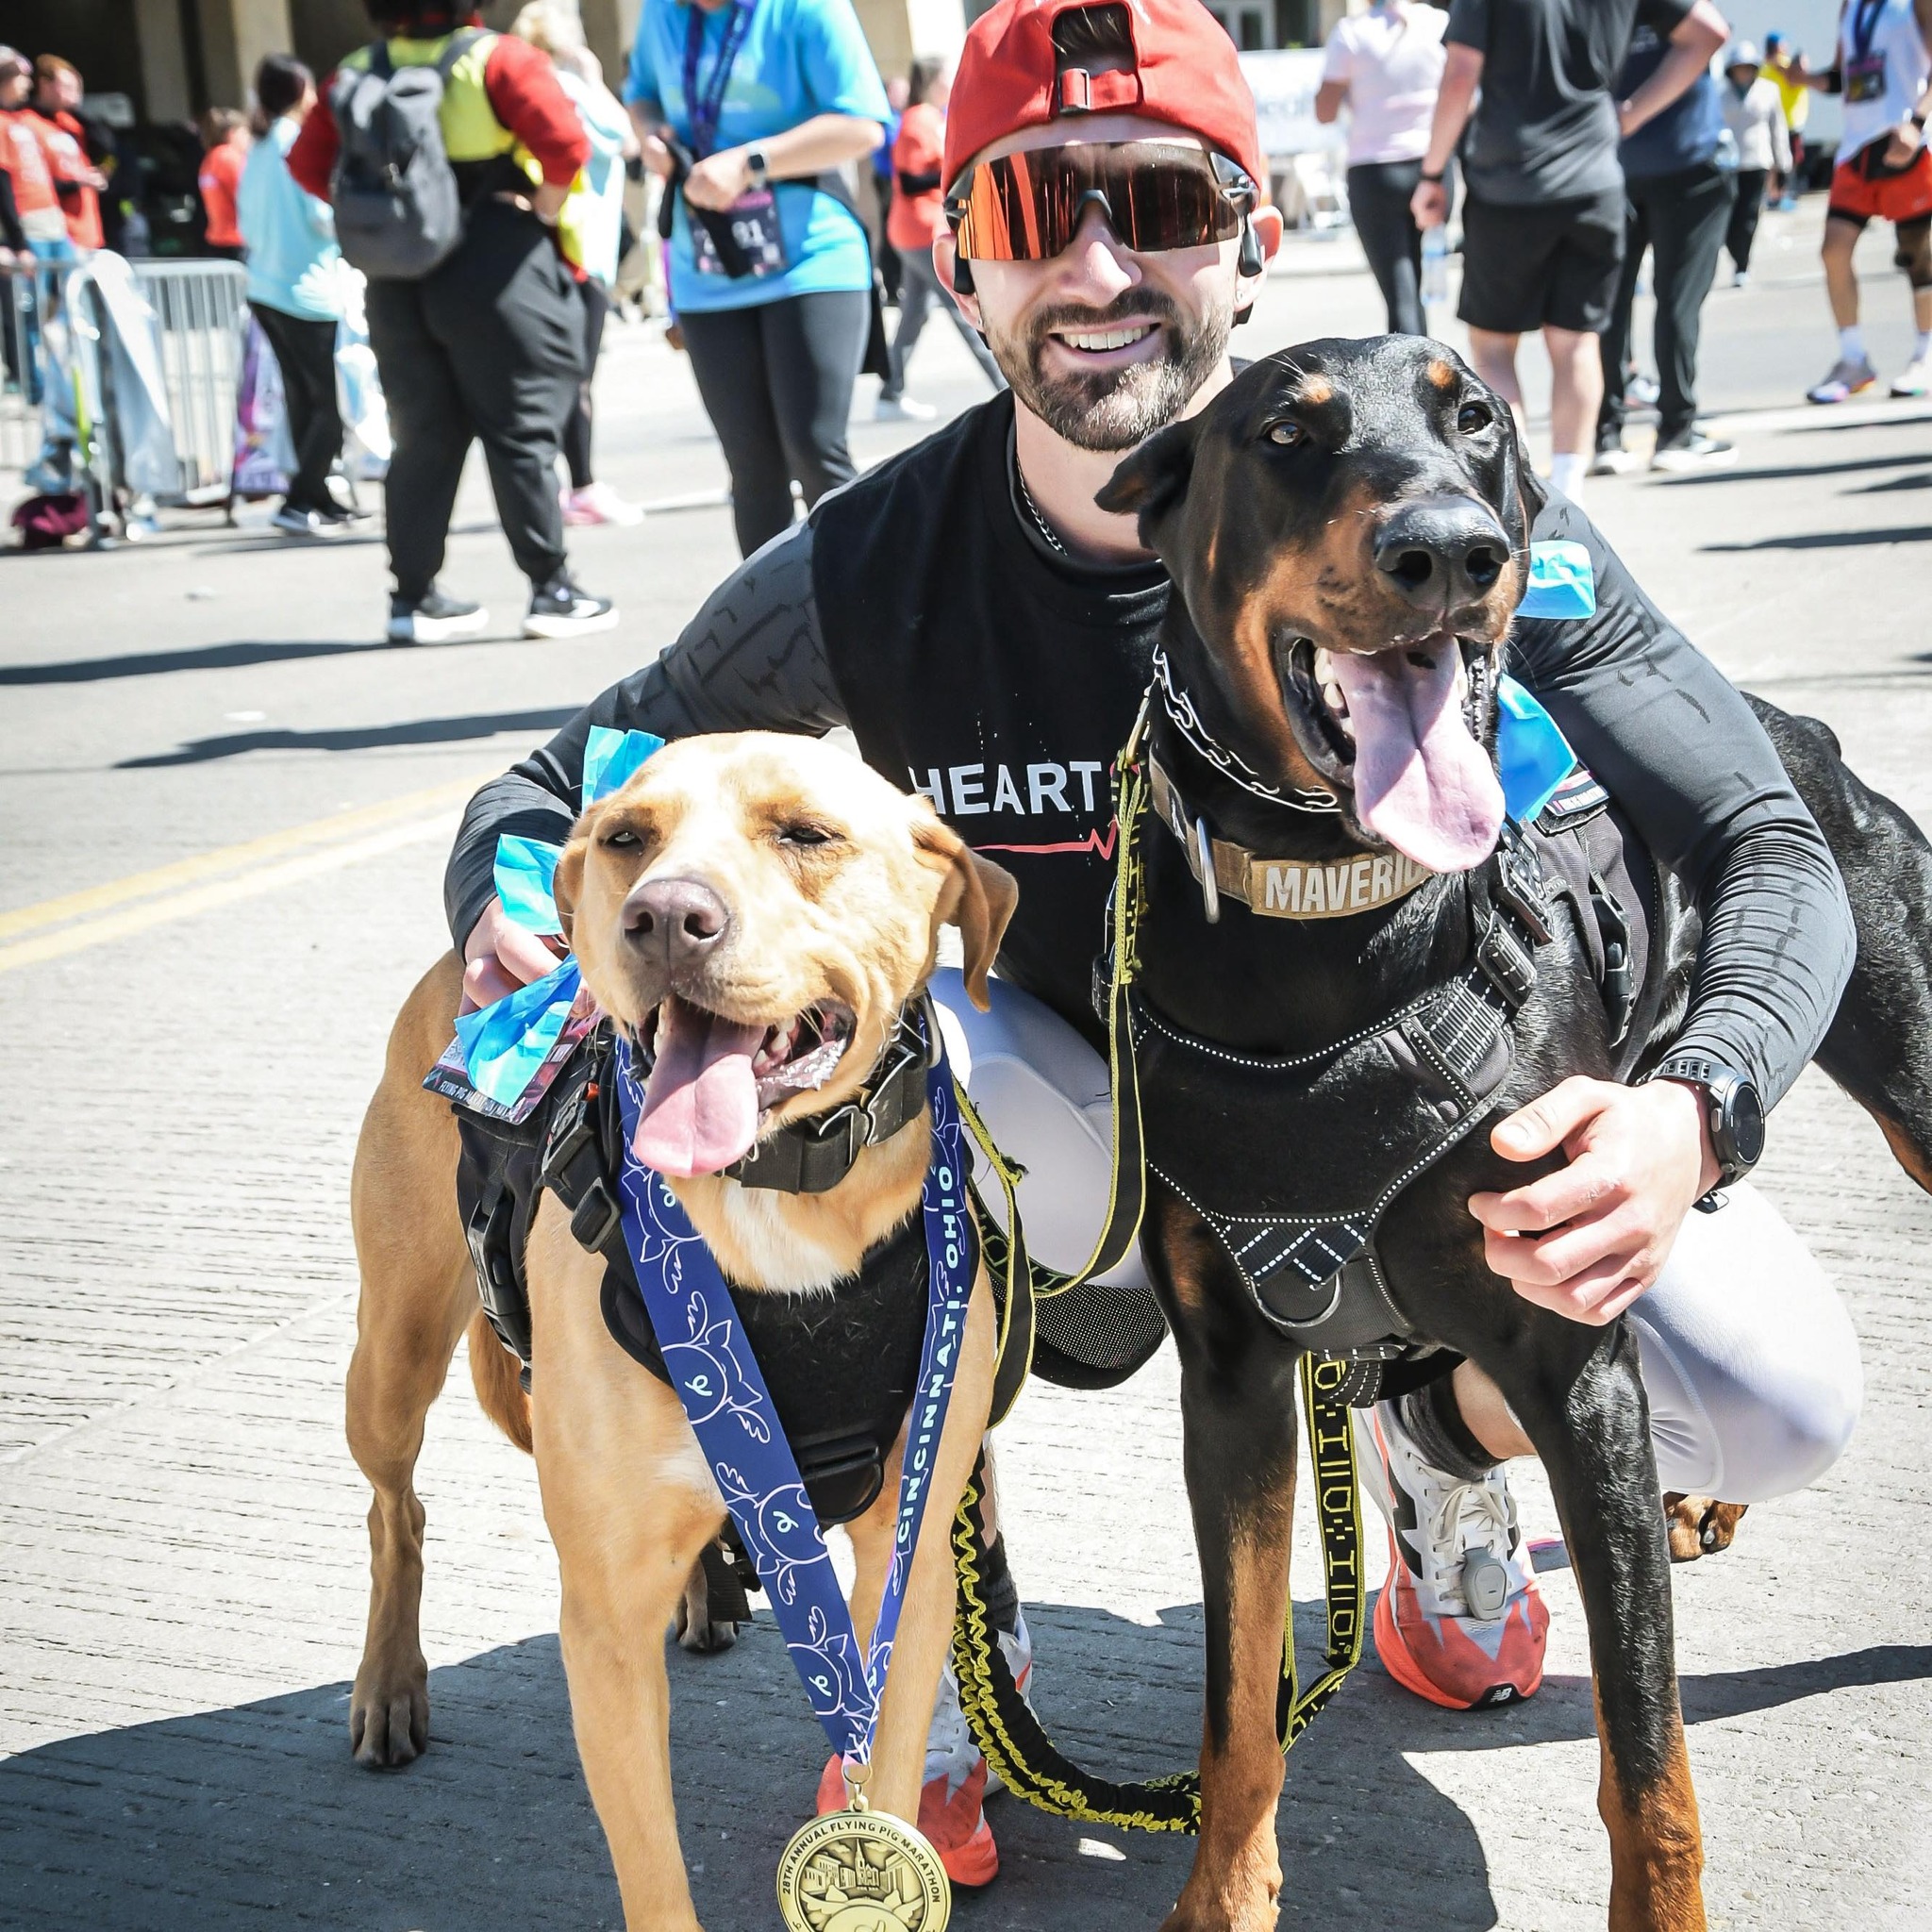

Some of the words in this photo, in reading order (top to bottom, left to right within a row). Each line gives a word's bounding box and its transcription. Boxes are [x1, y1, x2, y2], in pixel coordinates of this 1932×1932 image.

[908, 761, 1102, 815] HEART
[455, 1087, 468, 1100] PIG
[938, 1166, 958, 1269] OHIO
[782, 1864, 793, 1895] 28TH
[790, 1827, 828, 1864] ANNUAL
[830, 1821, 876, 1832] FLYING
[878, 1825, 900, 1841] PIG
[900, 1839, 941, 1903] MARATHON
